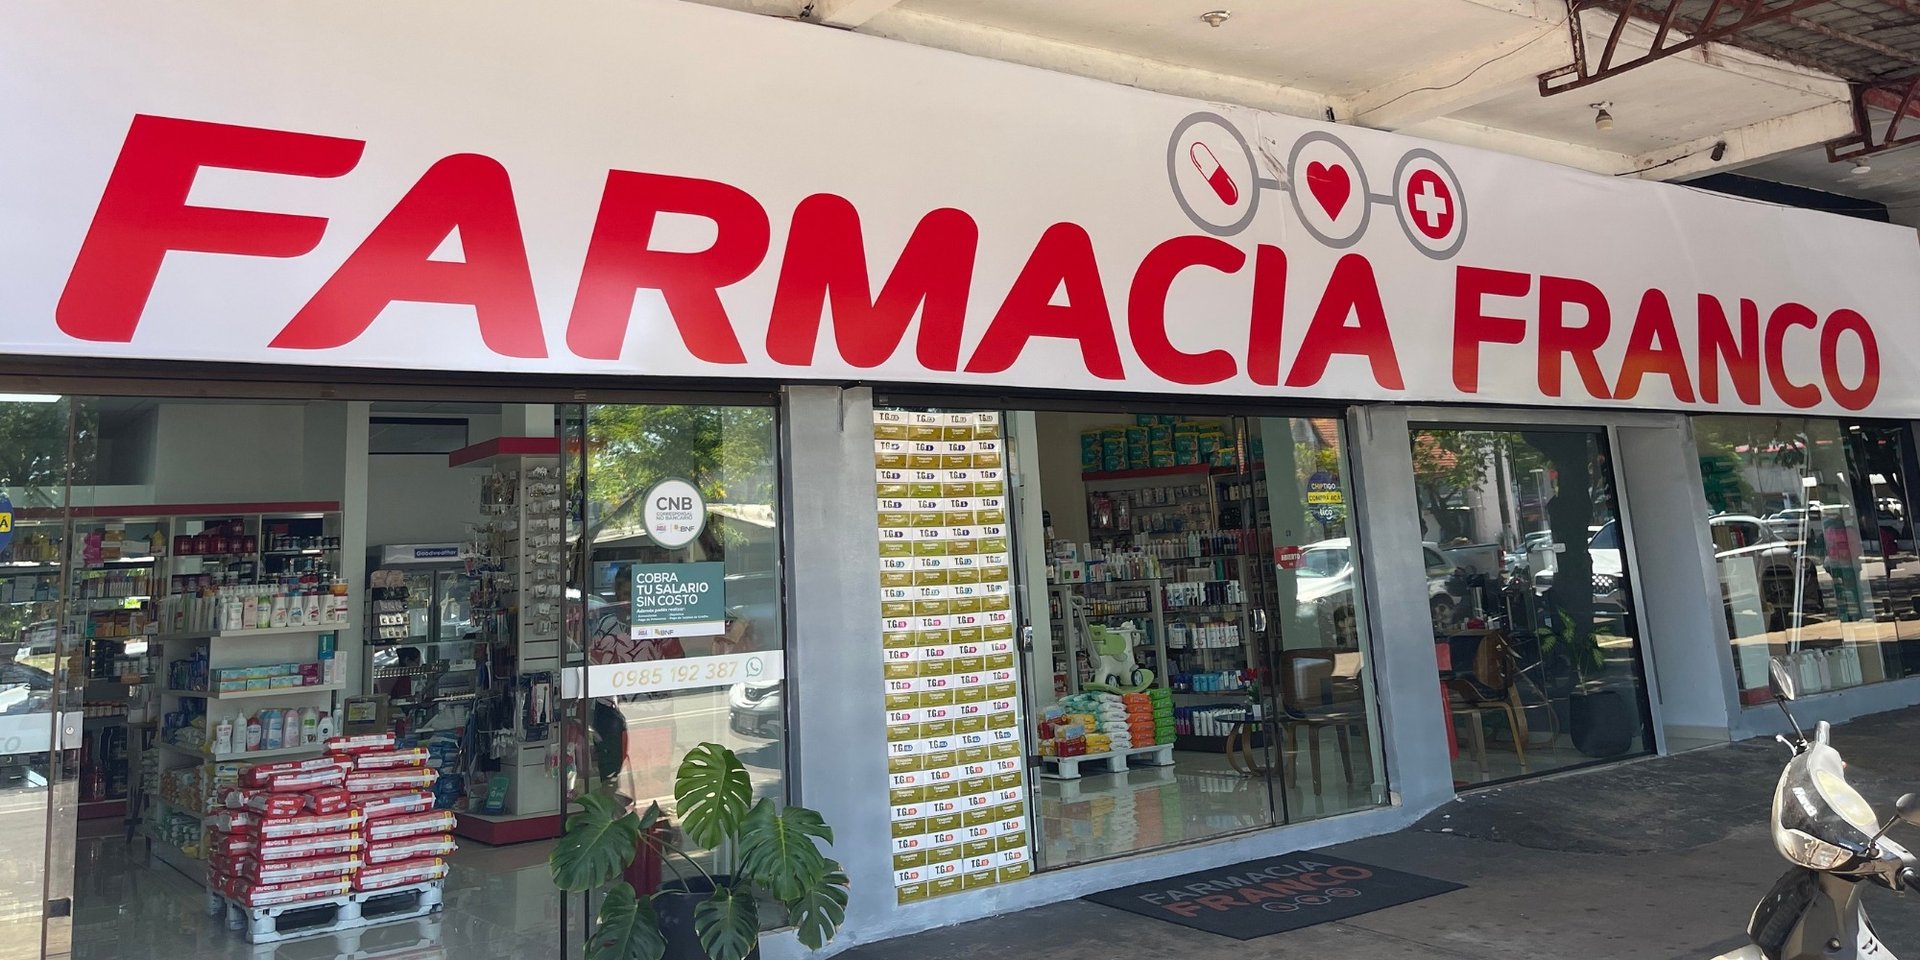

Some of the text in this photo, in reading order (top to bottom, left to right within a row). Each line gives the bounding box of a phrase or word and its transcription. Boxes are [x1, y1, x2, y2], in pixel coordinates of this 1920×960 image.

[56, 114, 1881, 411] FARMACIA FRANCO
[656, 496, 693, 511] CNB
[636, 572, 678, 584] COBRA
[636, 582, 709, 595] TU SALARIO
[636, 594, 698, 607] SIN COSTO
[611, 661, 739, 688] 0985 192 387
[1137, 860, 1332, 905] FARMACIA
[1160, 865, 1374, 918] FRANCO
